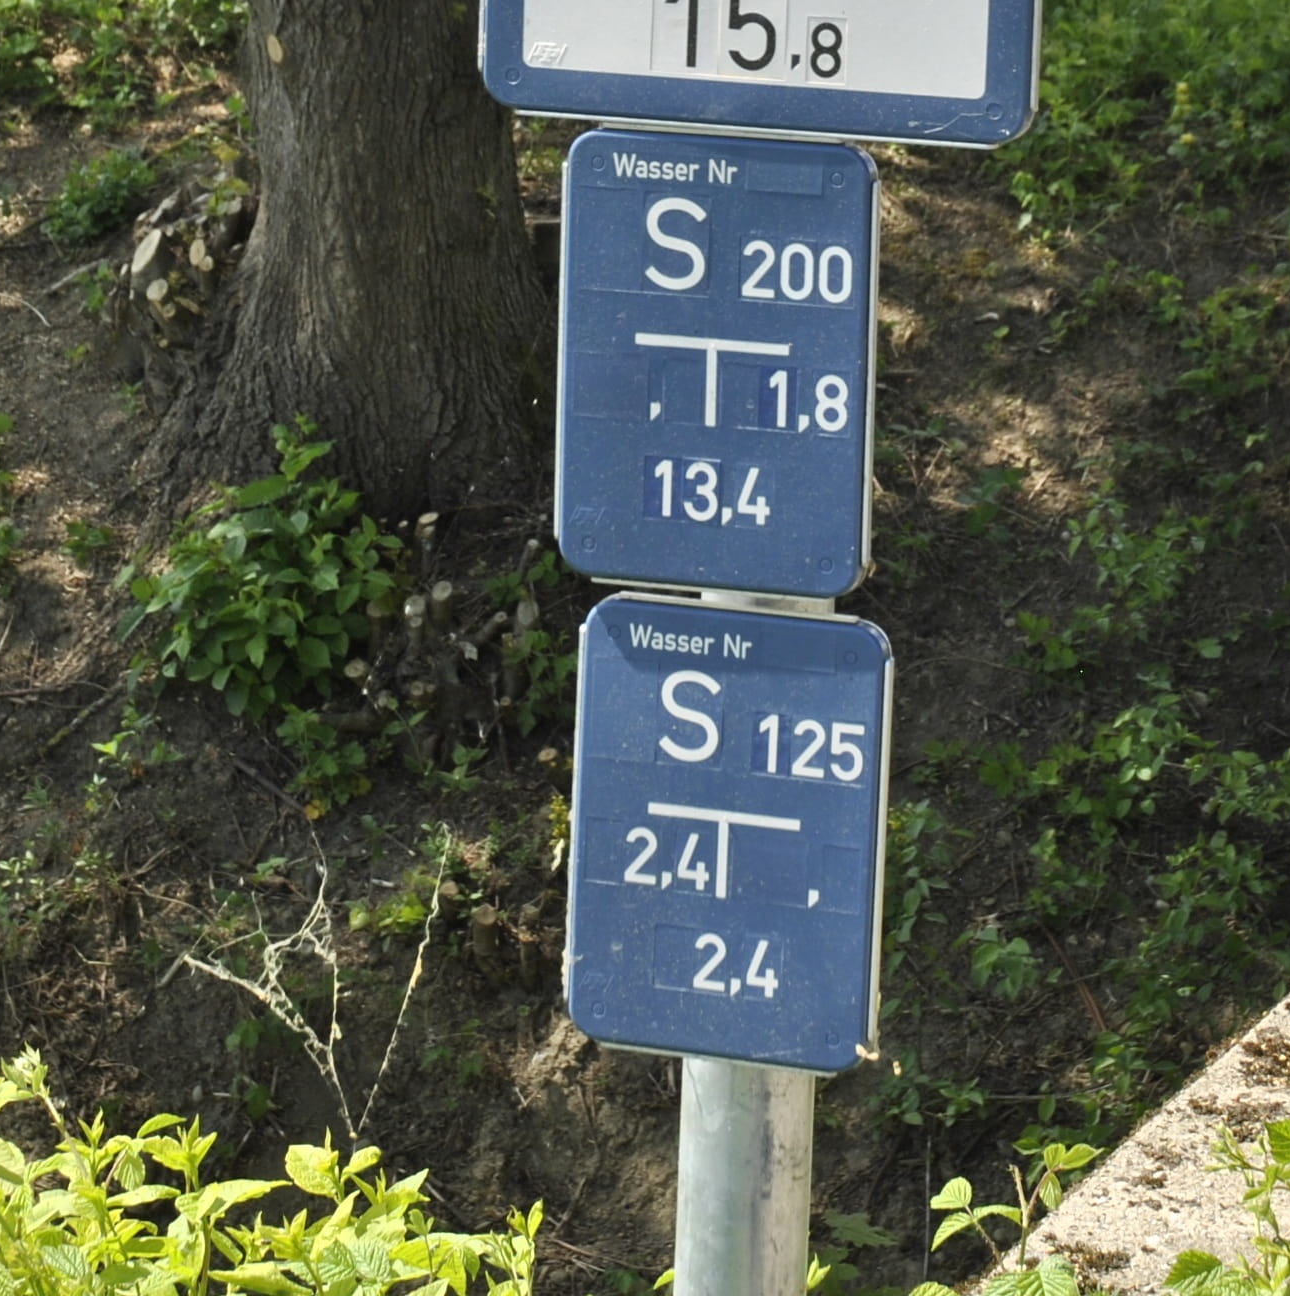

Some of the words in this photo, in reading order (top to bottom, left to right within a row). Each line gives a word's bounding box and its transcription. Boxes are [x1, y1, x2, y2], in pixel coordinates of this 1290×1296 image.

[612, 151, 700, 182] Wasser
[708, 158, 738, 185] Nr
[644, 196, 708, 292] S
[741, 239, 854, 304] 200
[769, 369, 849, 433] 1,8
[654, 459, 771, 526] 13,4
[629, 622, 715, 655] Wasser
[722, 633, 752, 659] Nr
[658, 669, 723, 763] S
[758, 713, 866, 782] 125
[623, 826, 710, 891] 2,4
[692, 932, 779, 999] 2,4
